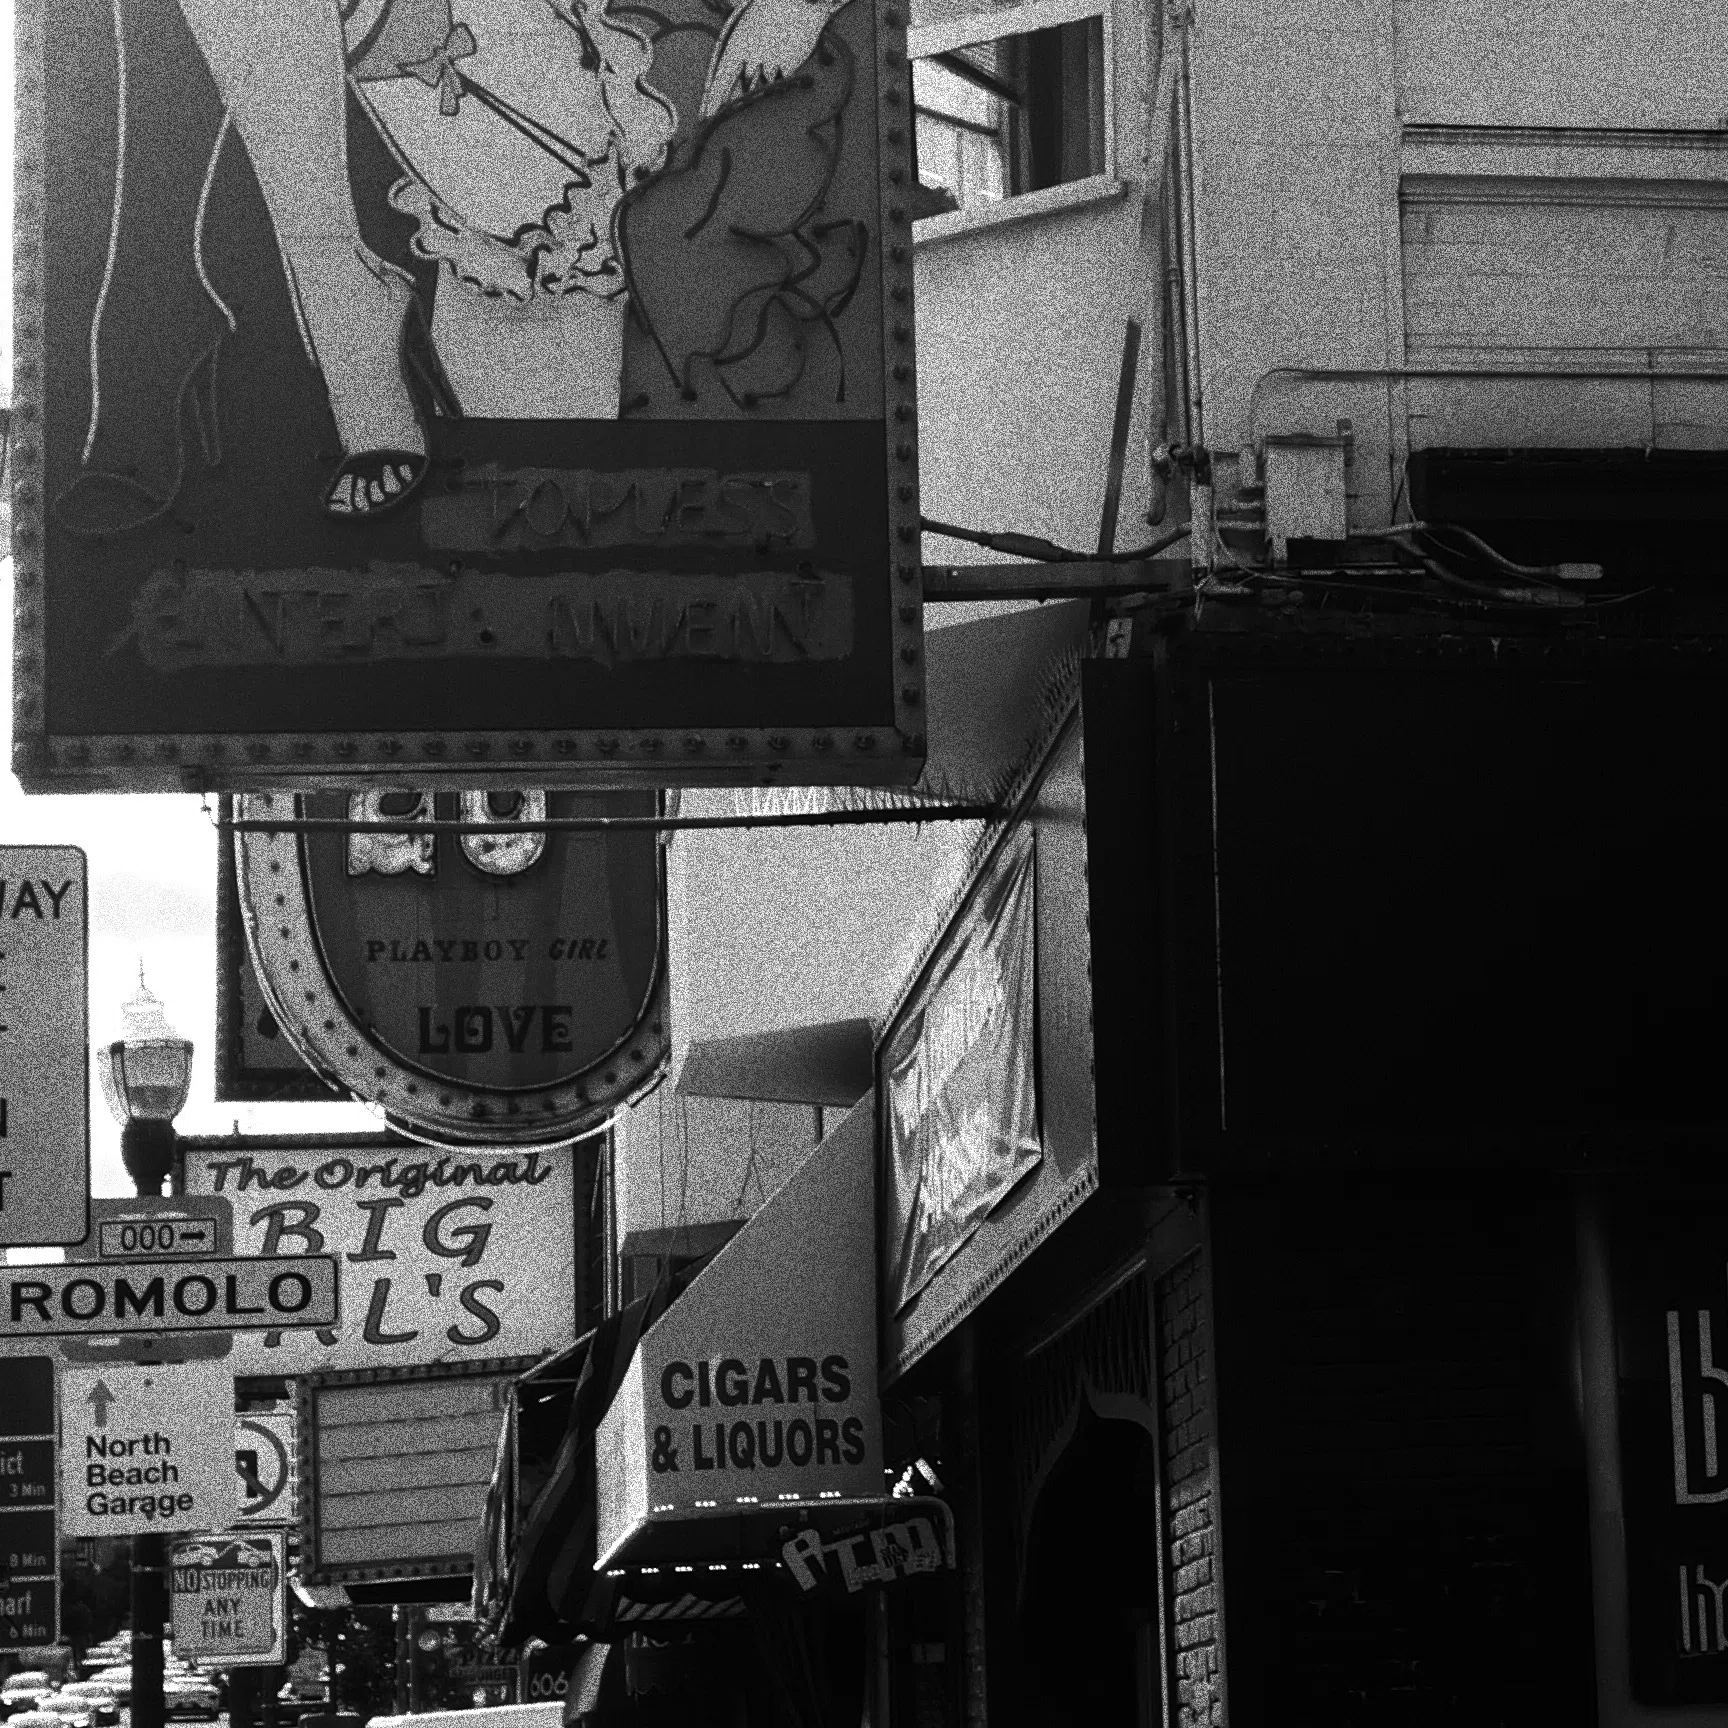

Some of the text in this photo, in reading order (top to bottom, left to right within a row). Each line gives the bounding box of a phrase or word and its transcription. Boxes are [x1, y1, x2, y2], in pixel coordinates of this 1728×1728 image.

[0, 881, 72, 919] AY
[366, 937, 609, 962] PLAYBOY GIRL
[417, 1005, 574, 1054] LOVE
[207, 1152, 552, 1198] The Original
[250, 1196, 495, 1268] BIG
[10, 1271, 314, 1323] ROMOLO
[263, 1273, 505, 1347] L'S
[660, 1355, 851, 1410] CIGARS
[86, 1432, 171, 1458] North
[650, 1416, 866, 1474] & LIQUORS
[86, 1460, 179, 1487] Beach
[21, 1481, 46, 1497] Min
[86, 1493, 195, 1519] Garage
[22, 1552, 47, 1567] Min
[173, 1567, 271, 1592] NO STOPPING
[204, 1598, 241, 1617] ANY
[22, 1622, 47, 1638] Min
[201, 1620, 245, 1640] TIME
[530, 1669, 569, 1697] 606
